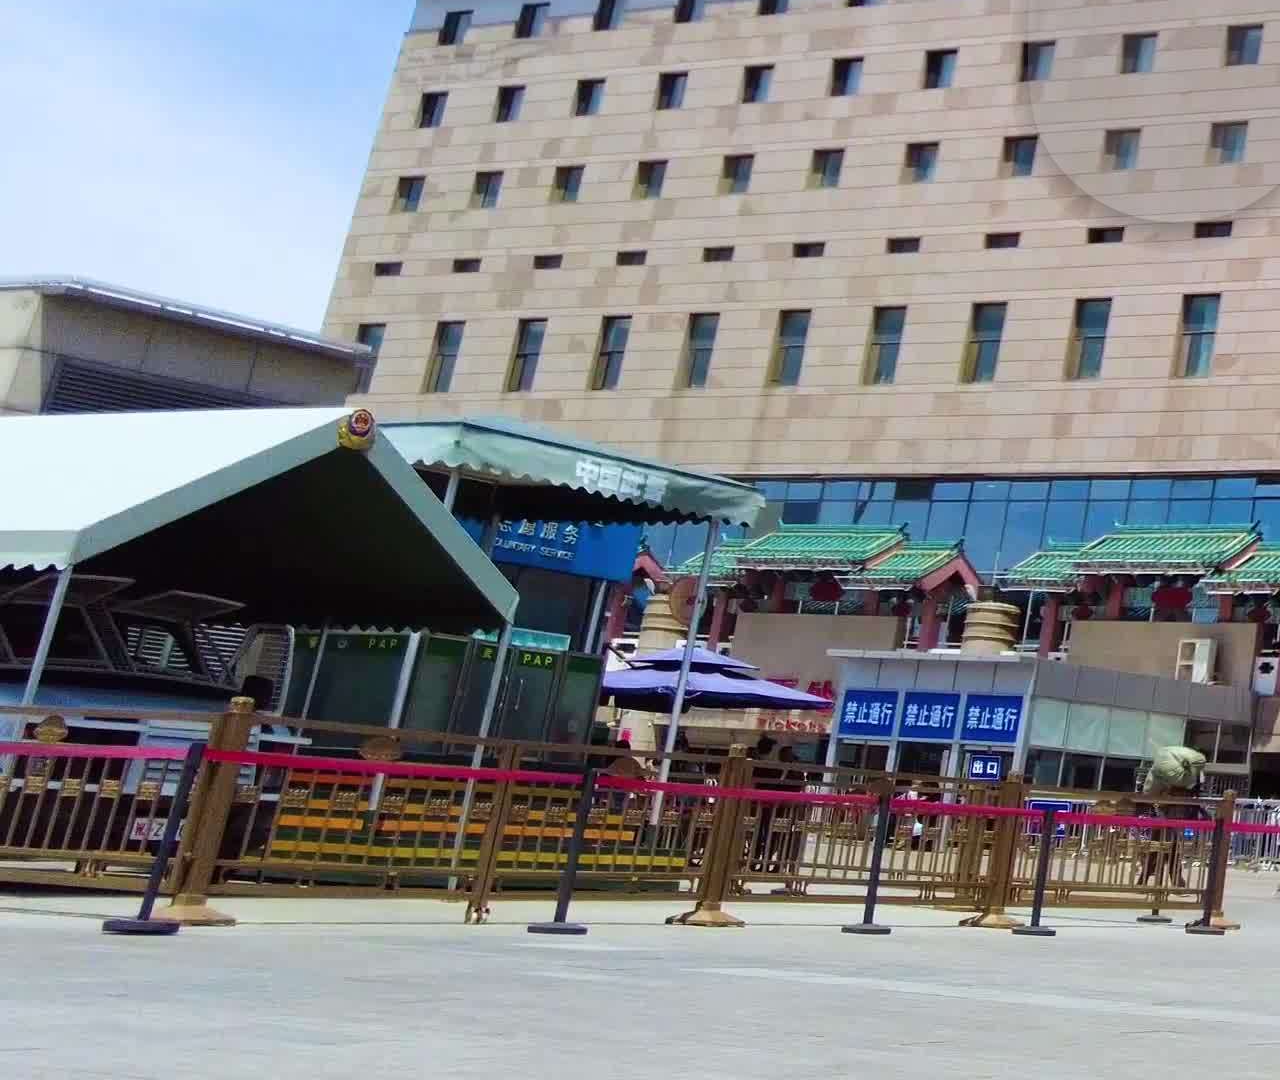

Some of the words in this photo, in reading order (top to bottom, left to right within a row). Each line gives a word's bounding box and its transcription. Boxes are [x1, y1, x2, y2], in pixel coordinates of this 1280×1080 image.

[496, 537, 536, 552] OLUNTARY
[368, 638, 399, 649] PAP
[523, 653, 553, 666] PAP
[844, 700, 895, 726] 禁止通行
[905, 702, 955, 729] 禁止通行
[967, 704, 1018, 732] 禁止通行
[972, 760, 998, 775] 出口
